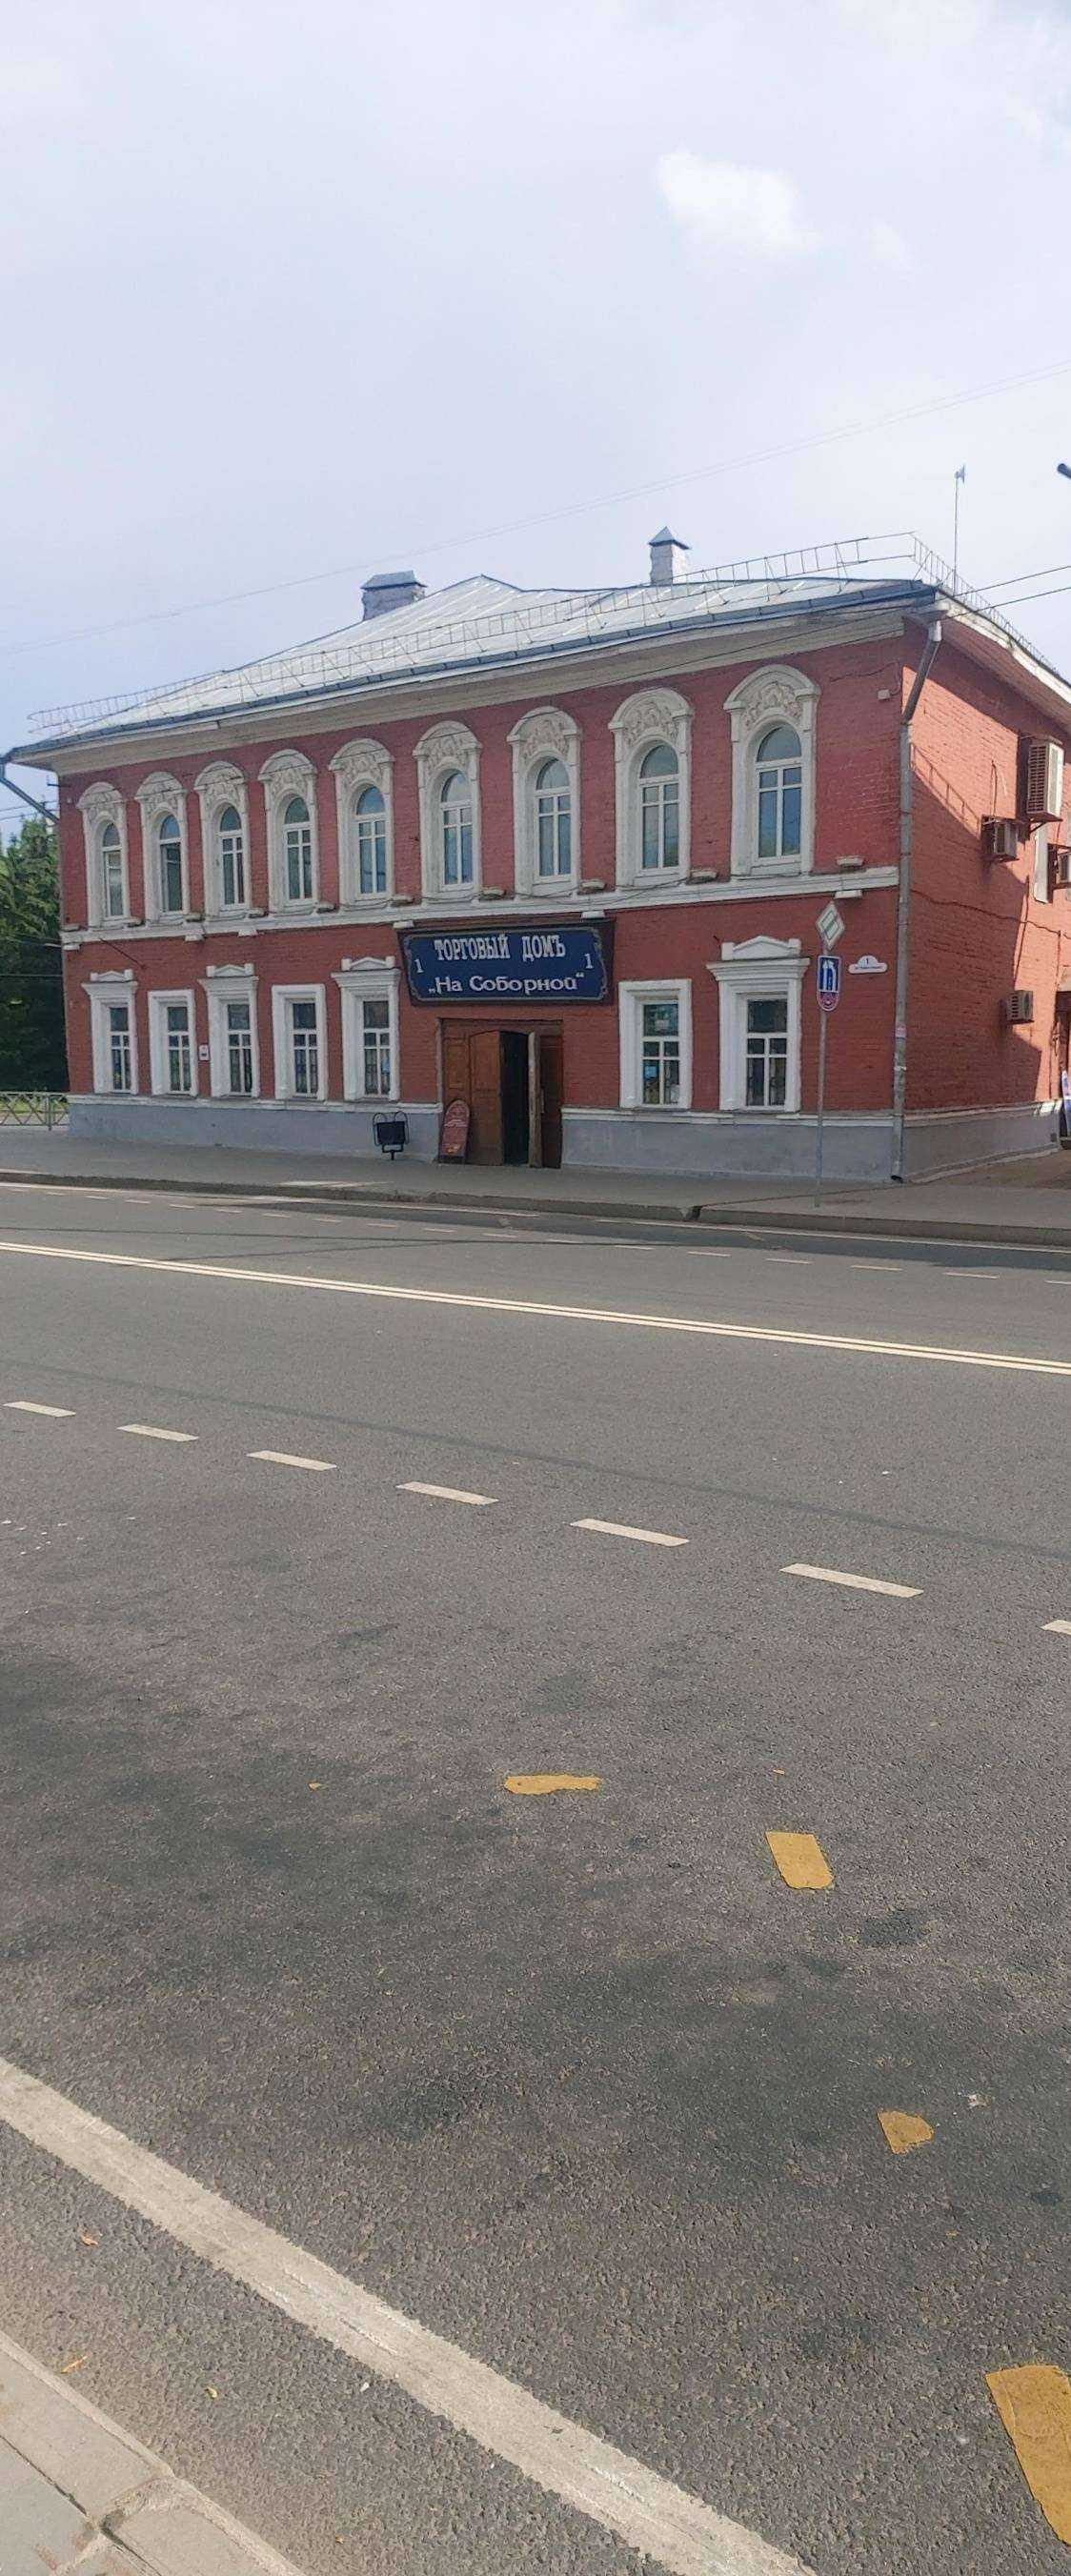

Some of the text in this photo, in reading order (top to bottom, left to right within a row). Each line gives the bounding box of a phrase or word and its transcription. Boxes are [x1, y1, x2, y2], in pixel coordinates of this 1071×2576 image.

[434, 934, 566, 961] ТОРГОВЫЙ ДОМЪ
[414, 958, 424, 973] 1
[584, 954, 593, 969] 1
